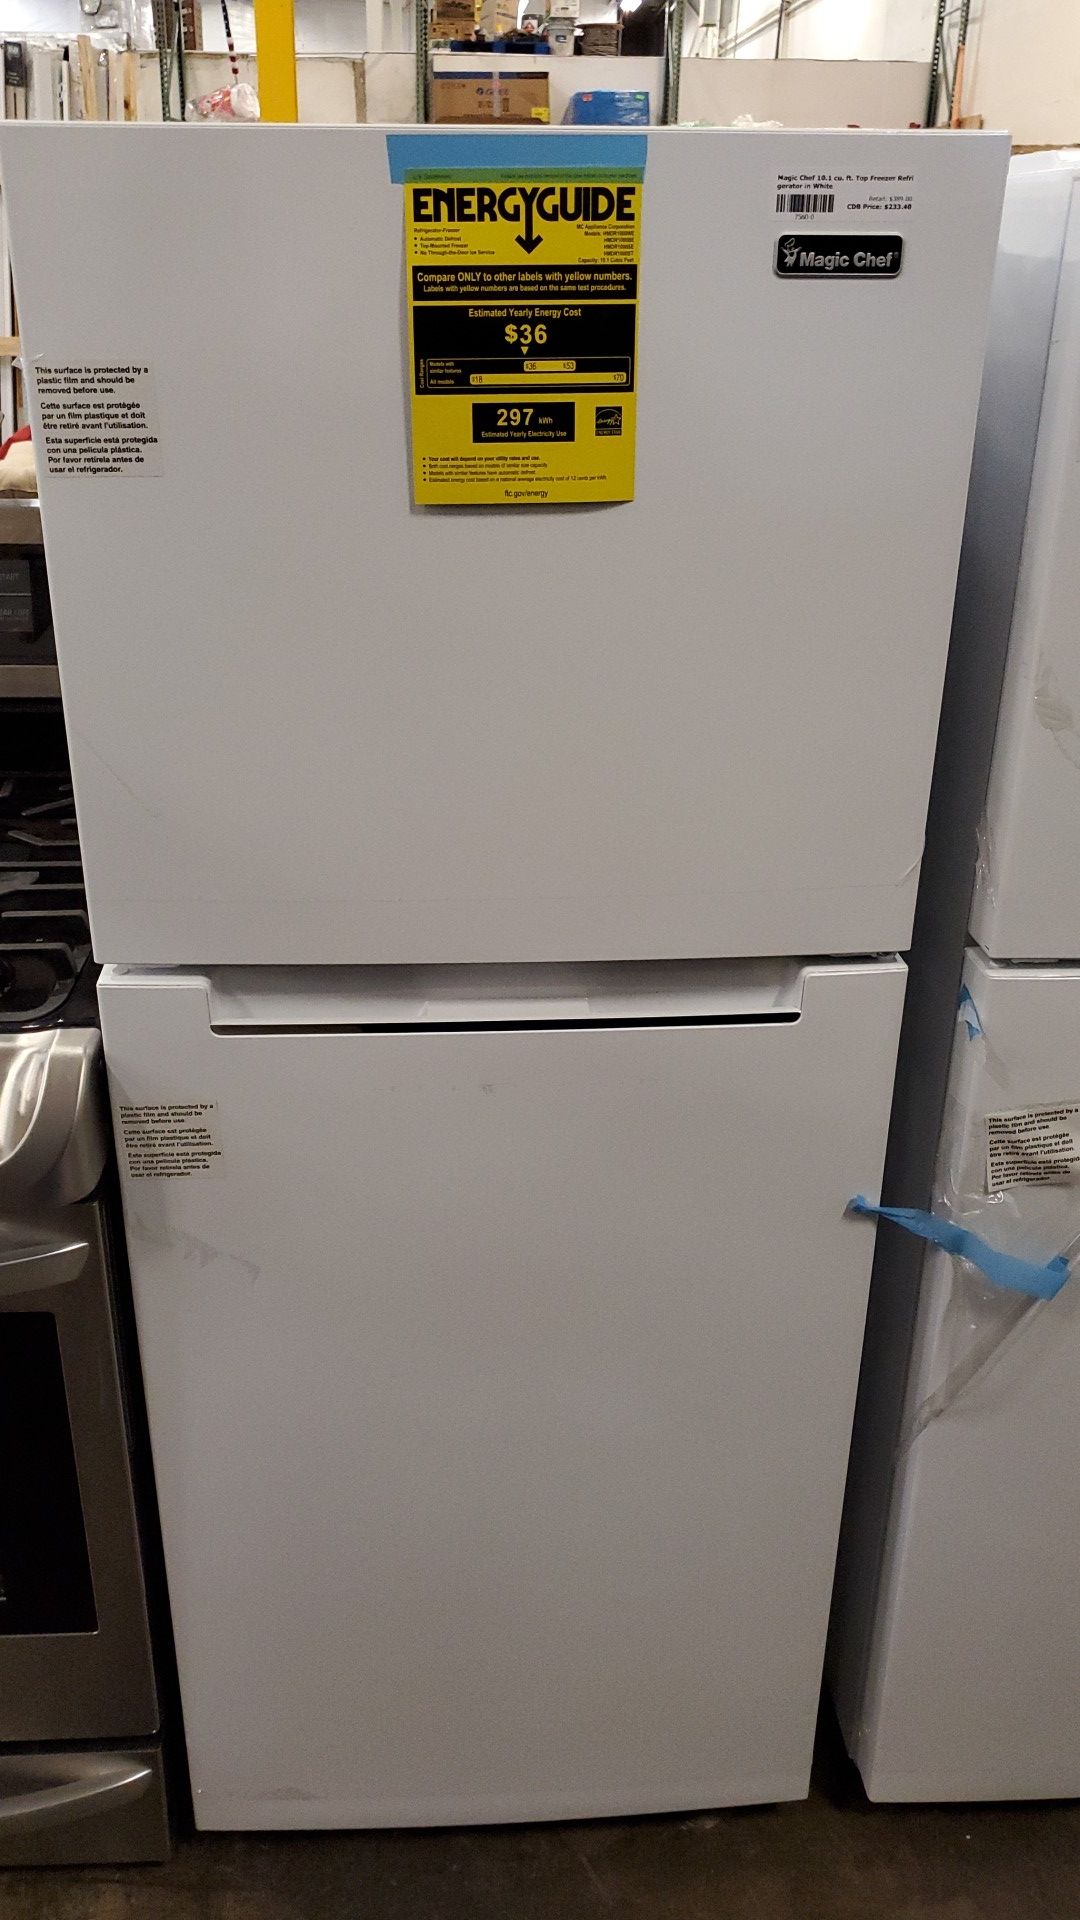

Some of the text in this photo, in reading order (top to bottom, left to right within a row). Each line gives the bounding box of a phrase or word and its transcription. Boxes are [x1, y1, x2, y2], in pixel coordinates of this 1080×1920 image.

[412, 187, 636, 223] ENERGYGUIDE
[800, 252, 893, 270] Magic Chef
[417, 271, 632, 283] Compare ONLY to other labels with yellow numbers.
[460, 285, 479, 293] yellow
[591, 284, 626, 292] procedures.
[469, 308, 582, 319] Estimated Yearly Energy Cost
[505, 324, 547, 344] $36
[94, 366, 130, 375] protected
[132, 366, 141, 375] by
[41, 402, 60, 410] Cette
[84, 412, 119, 421] plastique
[497, 409, 534, 426] 297
[528, 430, 555, 438] Electricity
[65, 437, 102, 445] superficie
[122, 436, 158, 445] protegida
[111, 446, 142, 454] plástica.
[77, 466, 123, 474] refrigerador.
